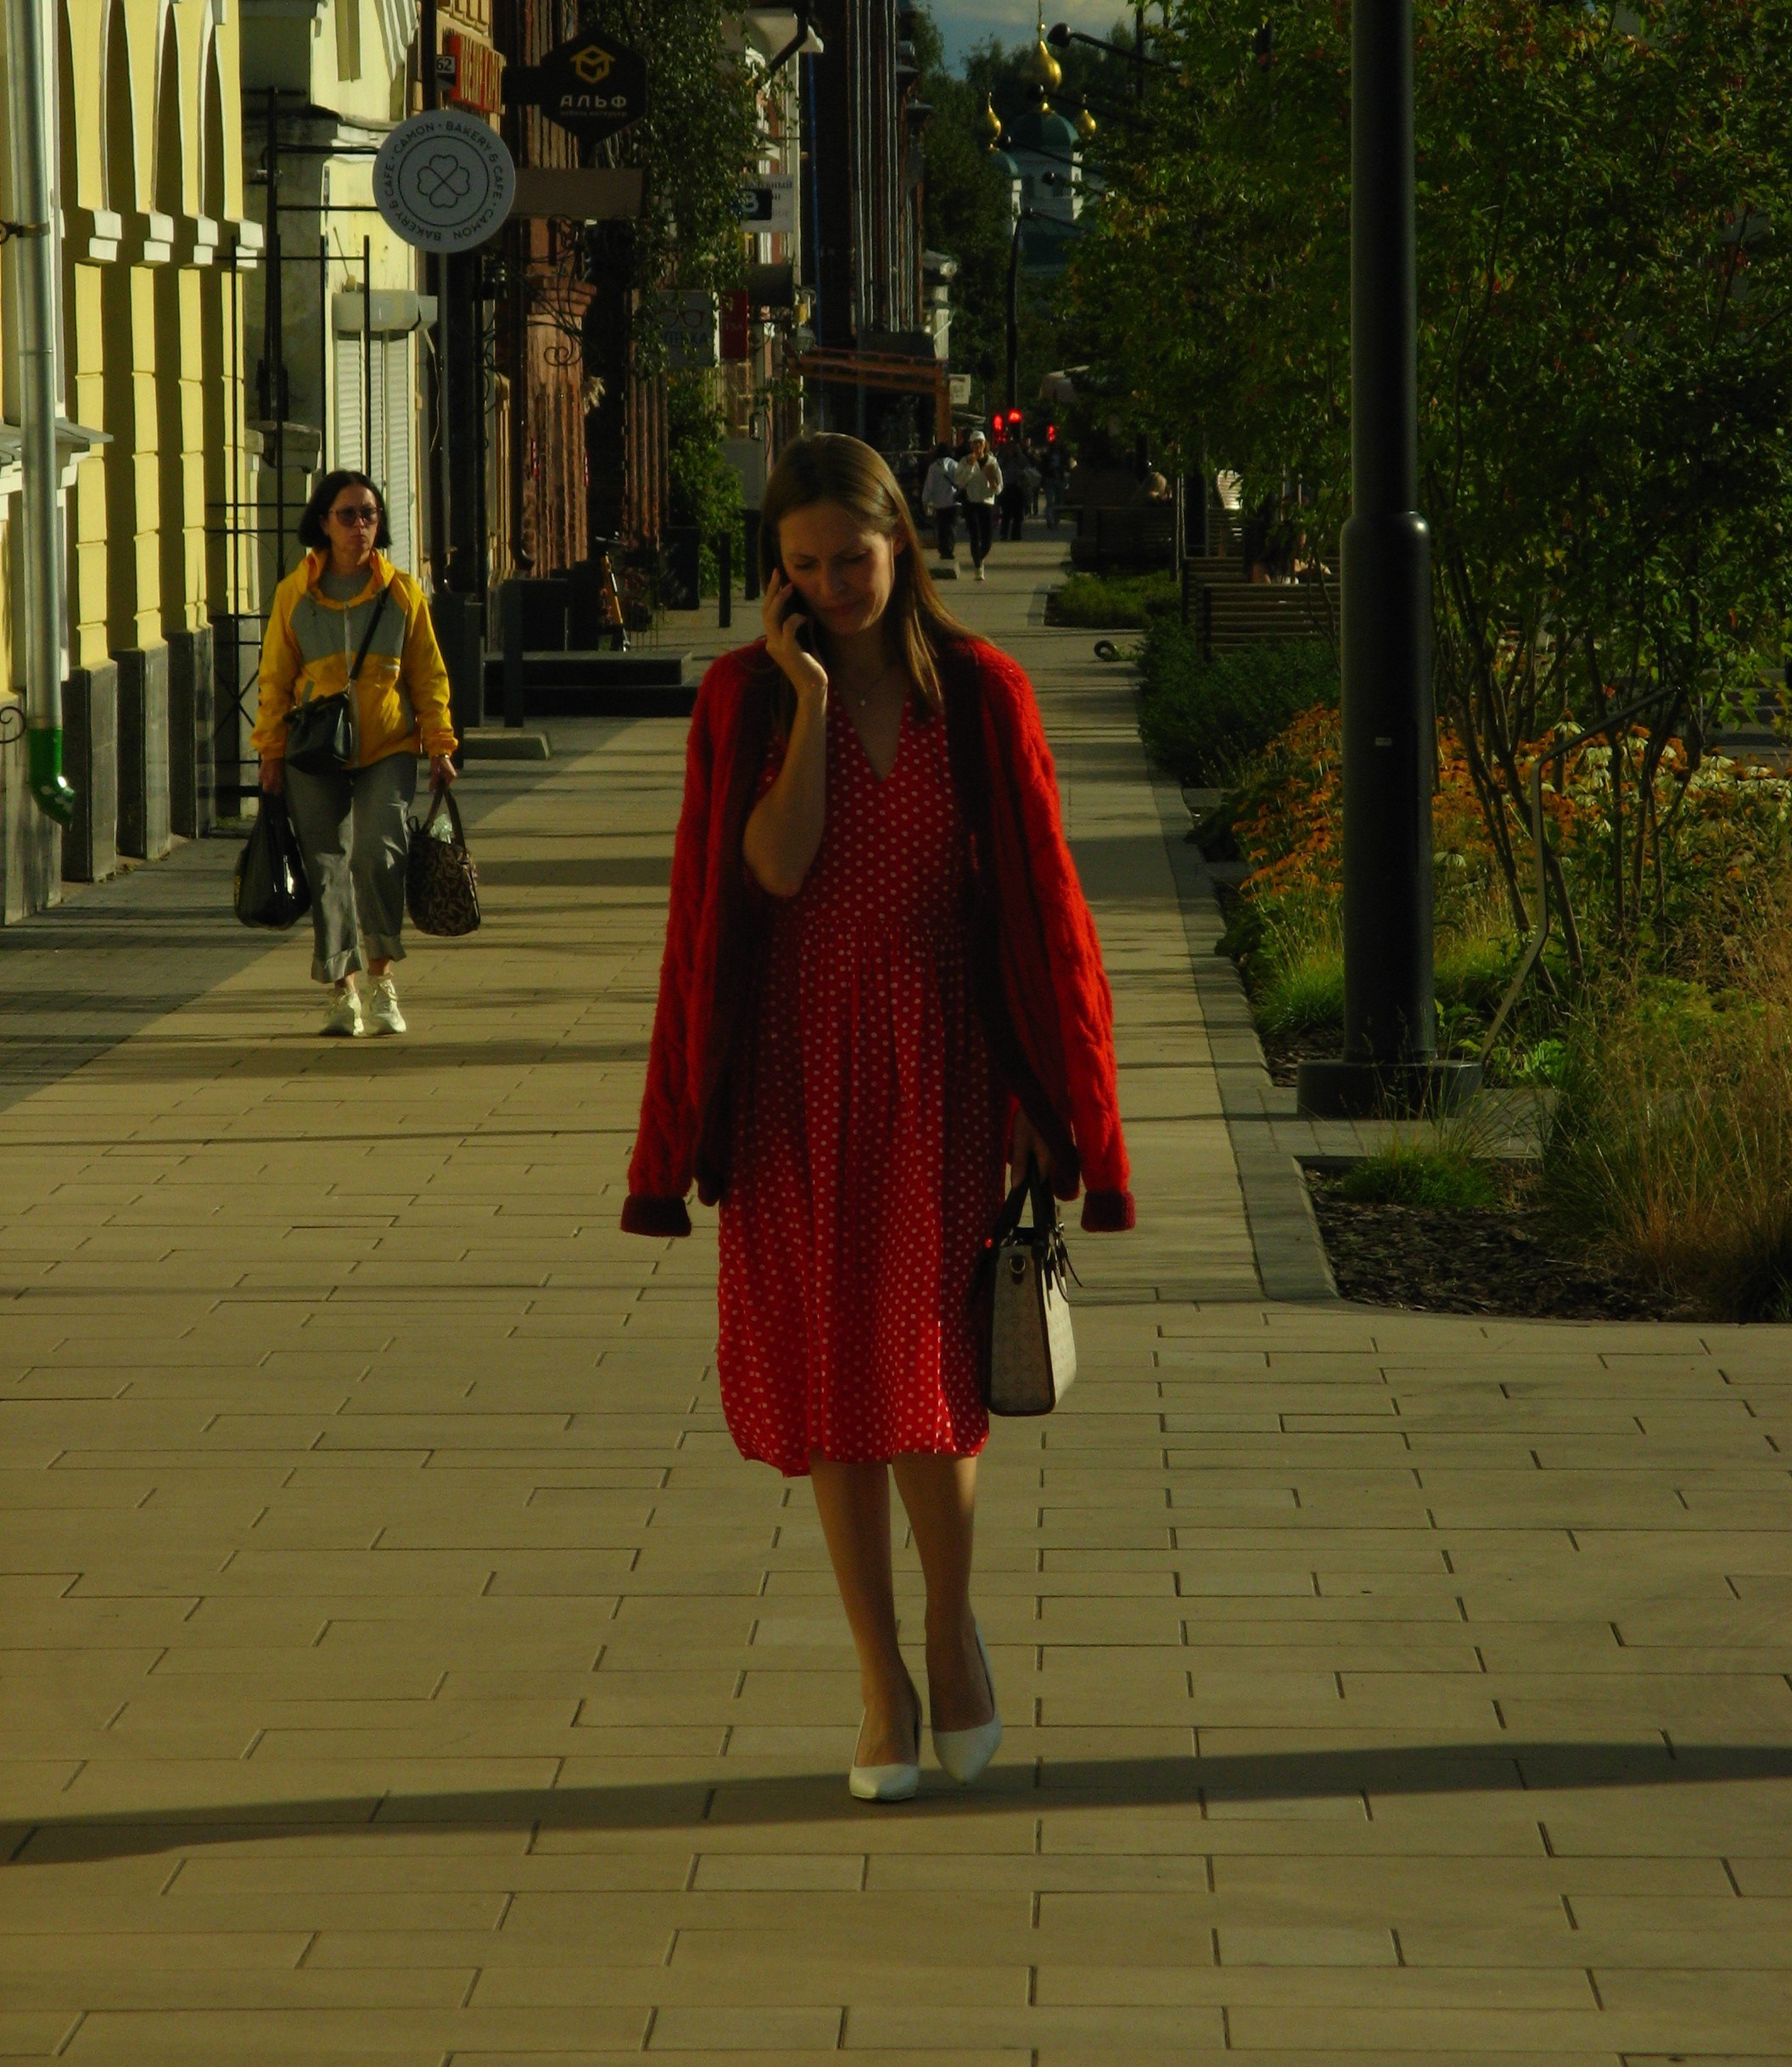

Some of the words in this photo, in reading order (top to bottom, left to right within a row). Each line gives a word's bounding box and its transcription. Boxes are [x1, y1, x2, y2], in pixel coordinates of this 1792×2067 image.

[436, 58, 451, 71] 62
[559, 94, 628, 109] АЛЬФ
[393, 122, 435, 154] CAMON
[445, 120, 492, 152] BAKERY
[492, 165, 504, 199] CAFE
[384, 163, 395, 198] CAFE
[395, 211, 442, 242] BAKERY
[453, 209, 495, 240] CAMON
